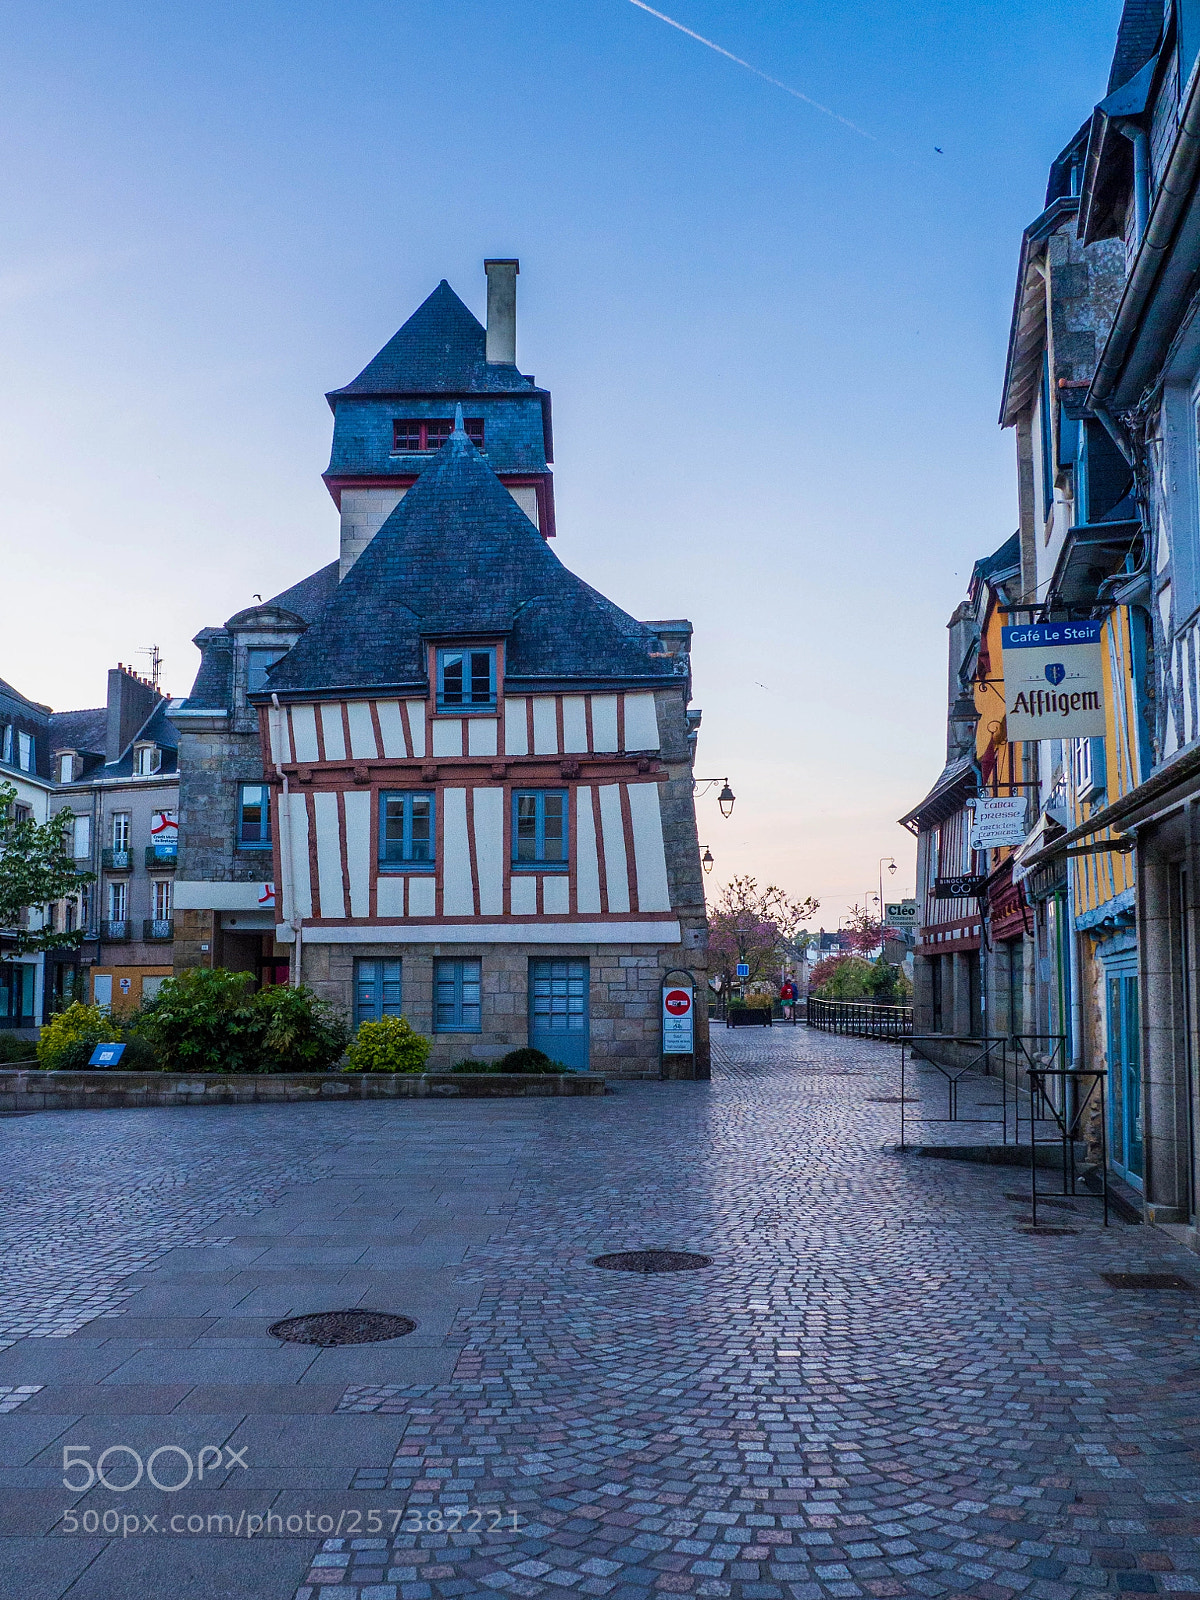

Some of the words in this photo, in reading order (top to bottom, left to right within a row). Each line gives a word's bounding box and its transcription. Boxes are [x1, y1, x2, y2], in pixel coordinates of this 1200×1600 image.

[1009, 630, 1040, 643] Café
[1044, 629, 1060, 641] Le
[1064, 627, 1096, 639] Steir
[1009, 689, 1102, 718] Affligem
[888, 905, 916, 916] Cléo
